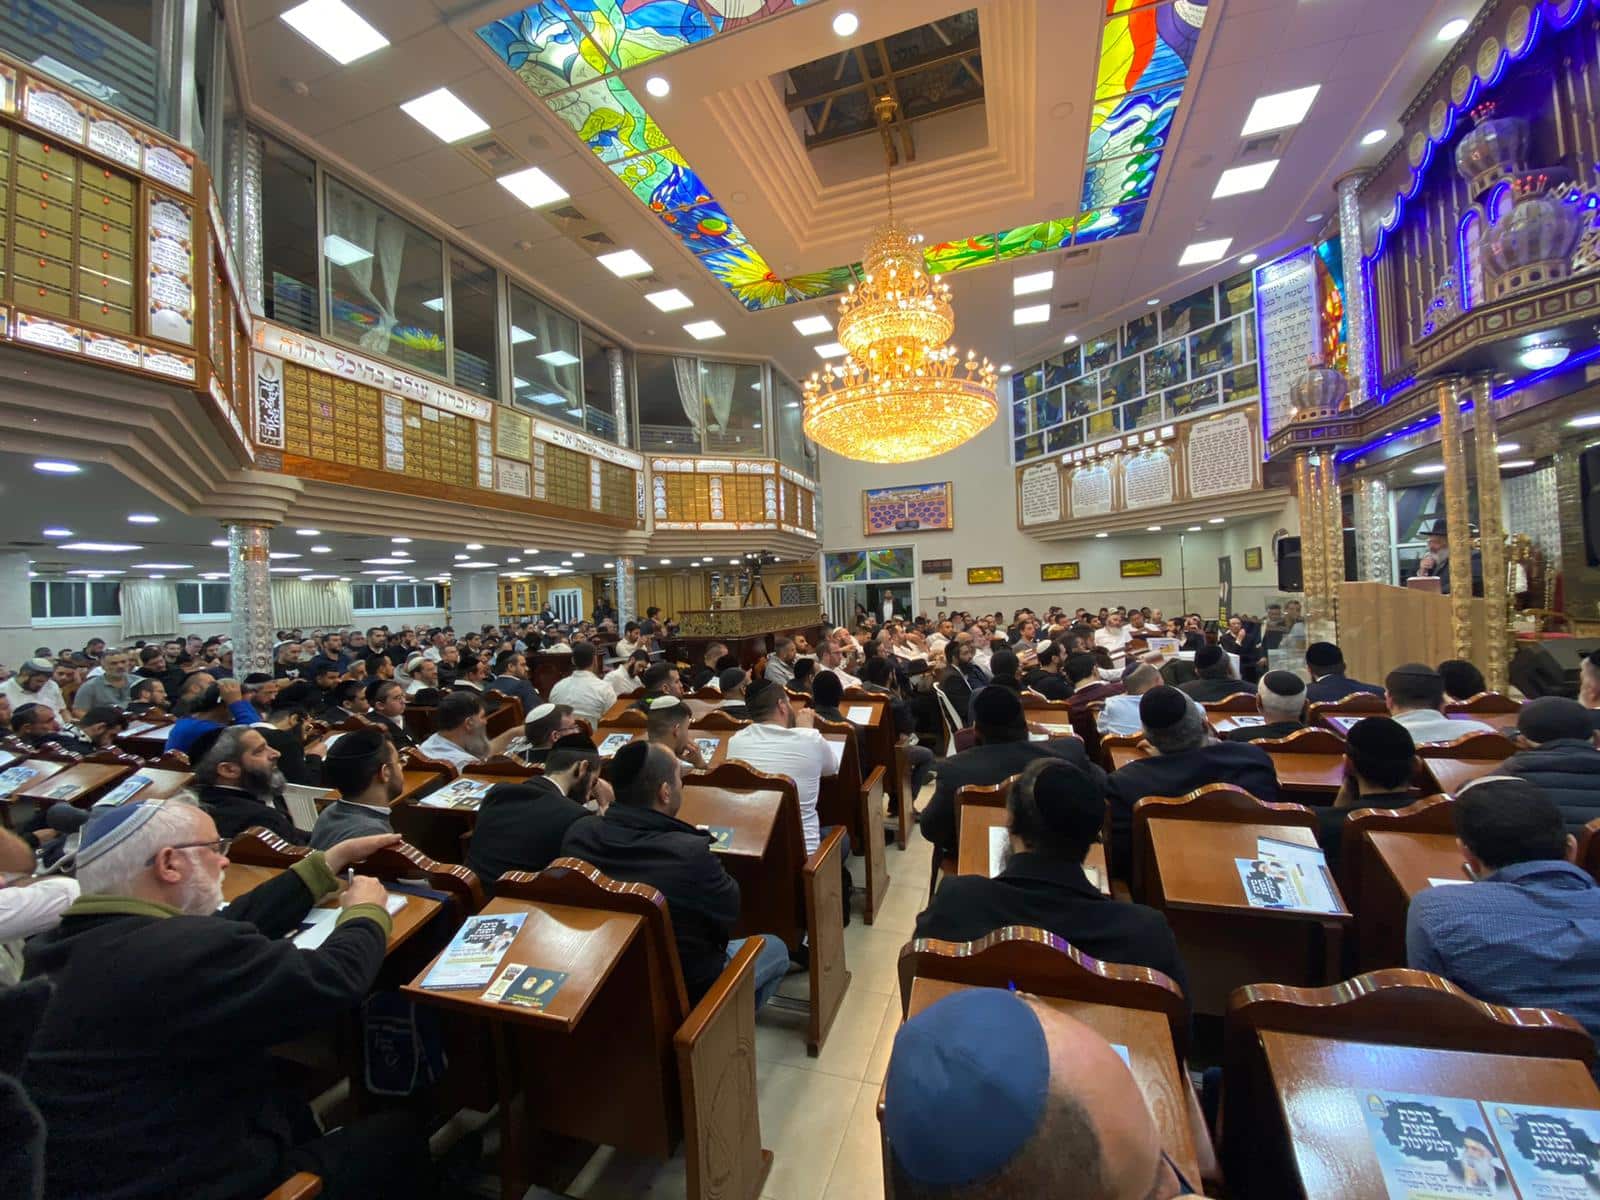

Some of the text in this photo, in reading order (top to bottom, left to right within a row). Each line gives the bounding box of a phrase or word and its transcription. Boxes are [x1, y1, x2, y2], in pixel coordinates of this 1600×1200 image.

[335, 351, 386, 385] בהיכל
[393, 375, 430, 401] עולם
[437, 389, 480, 413] לזכרון
[1397, 1108, 1435, 1124] ברכת
[1400, 1122, 1441, 1138] הפצת
[1527, 1120, 1567, 1136] ברכת
[1398, 1135, 1455, 1152] המעינות
[1532, 1135, 1575, 1151] הפצת
[1530, 1148, 1591, 1166] המעינות
